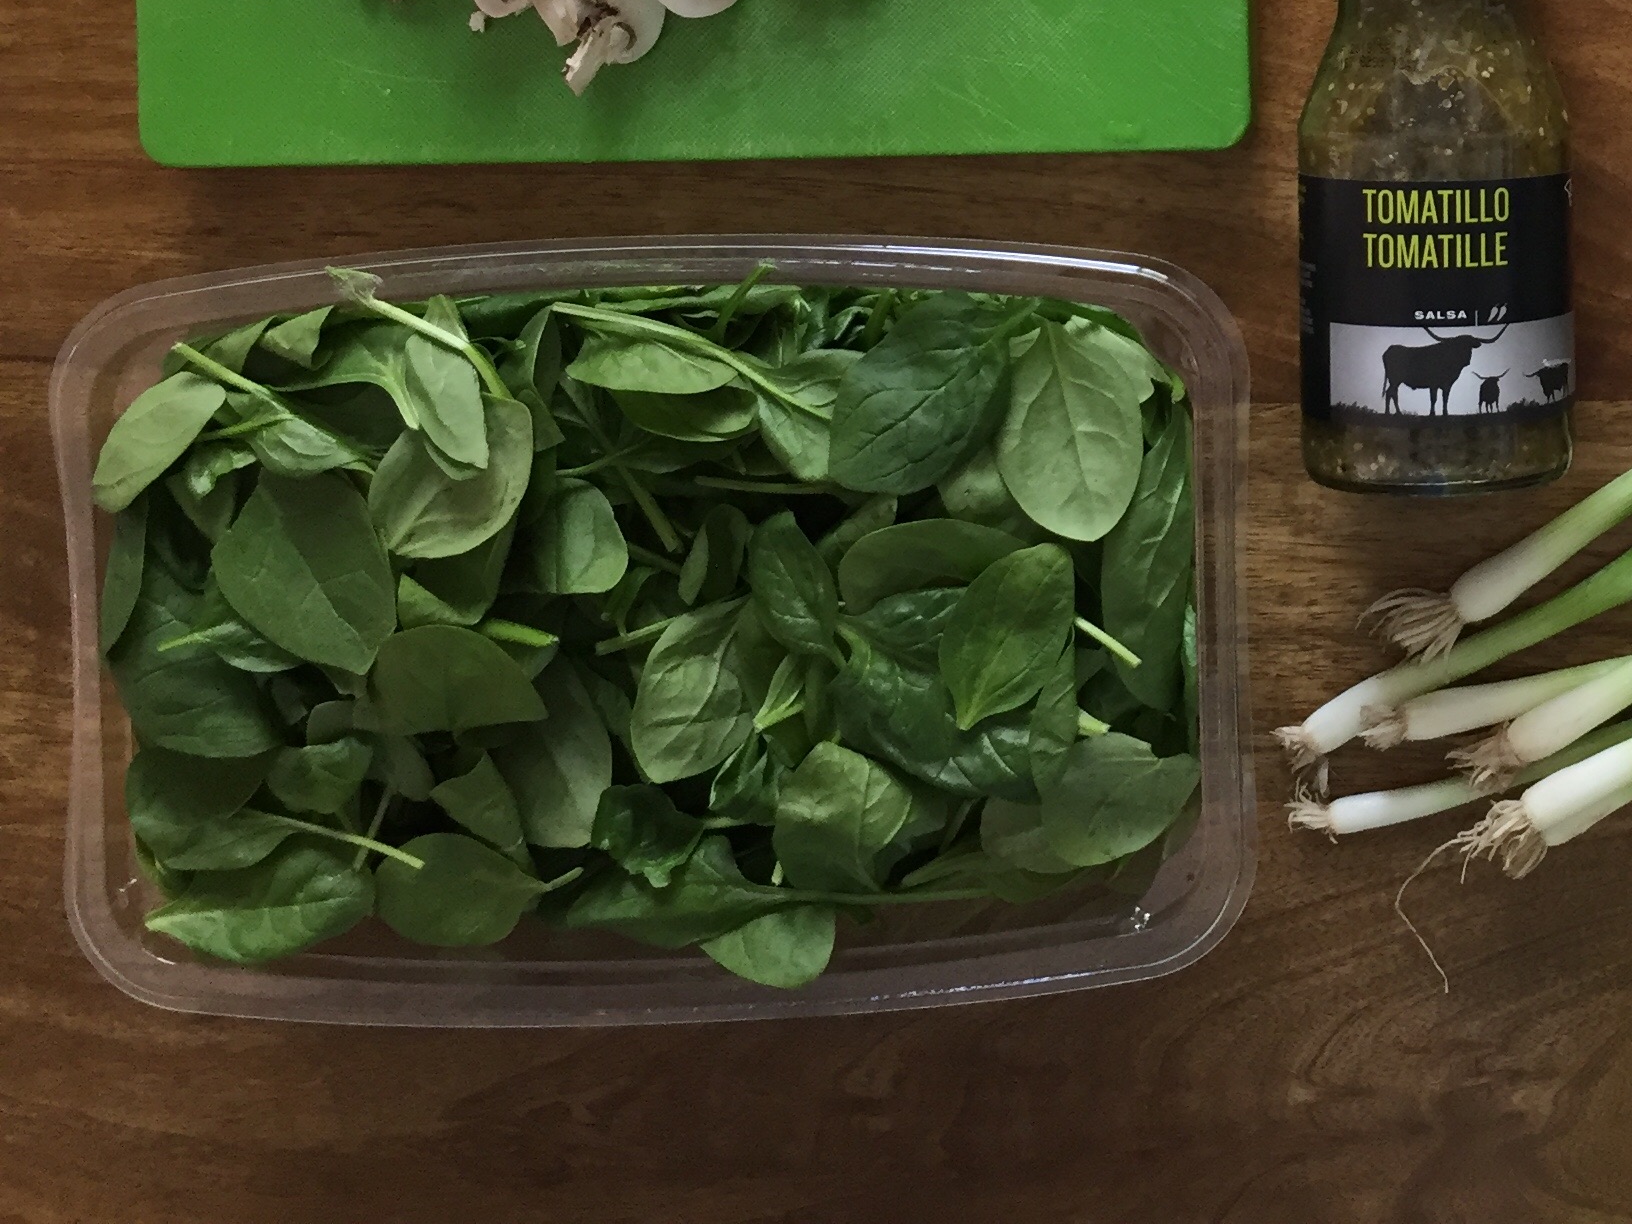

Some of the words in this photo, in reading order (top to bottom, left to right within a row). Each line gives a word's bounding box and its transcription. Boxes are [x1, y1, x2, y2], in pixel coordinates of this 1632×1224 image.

[1362, 187, 1509, 224] TOMATILLO
[1362, 232, 1508, 268] TOMATILLE
[1414, 310, 1467, 320] SALSA
